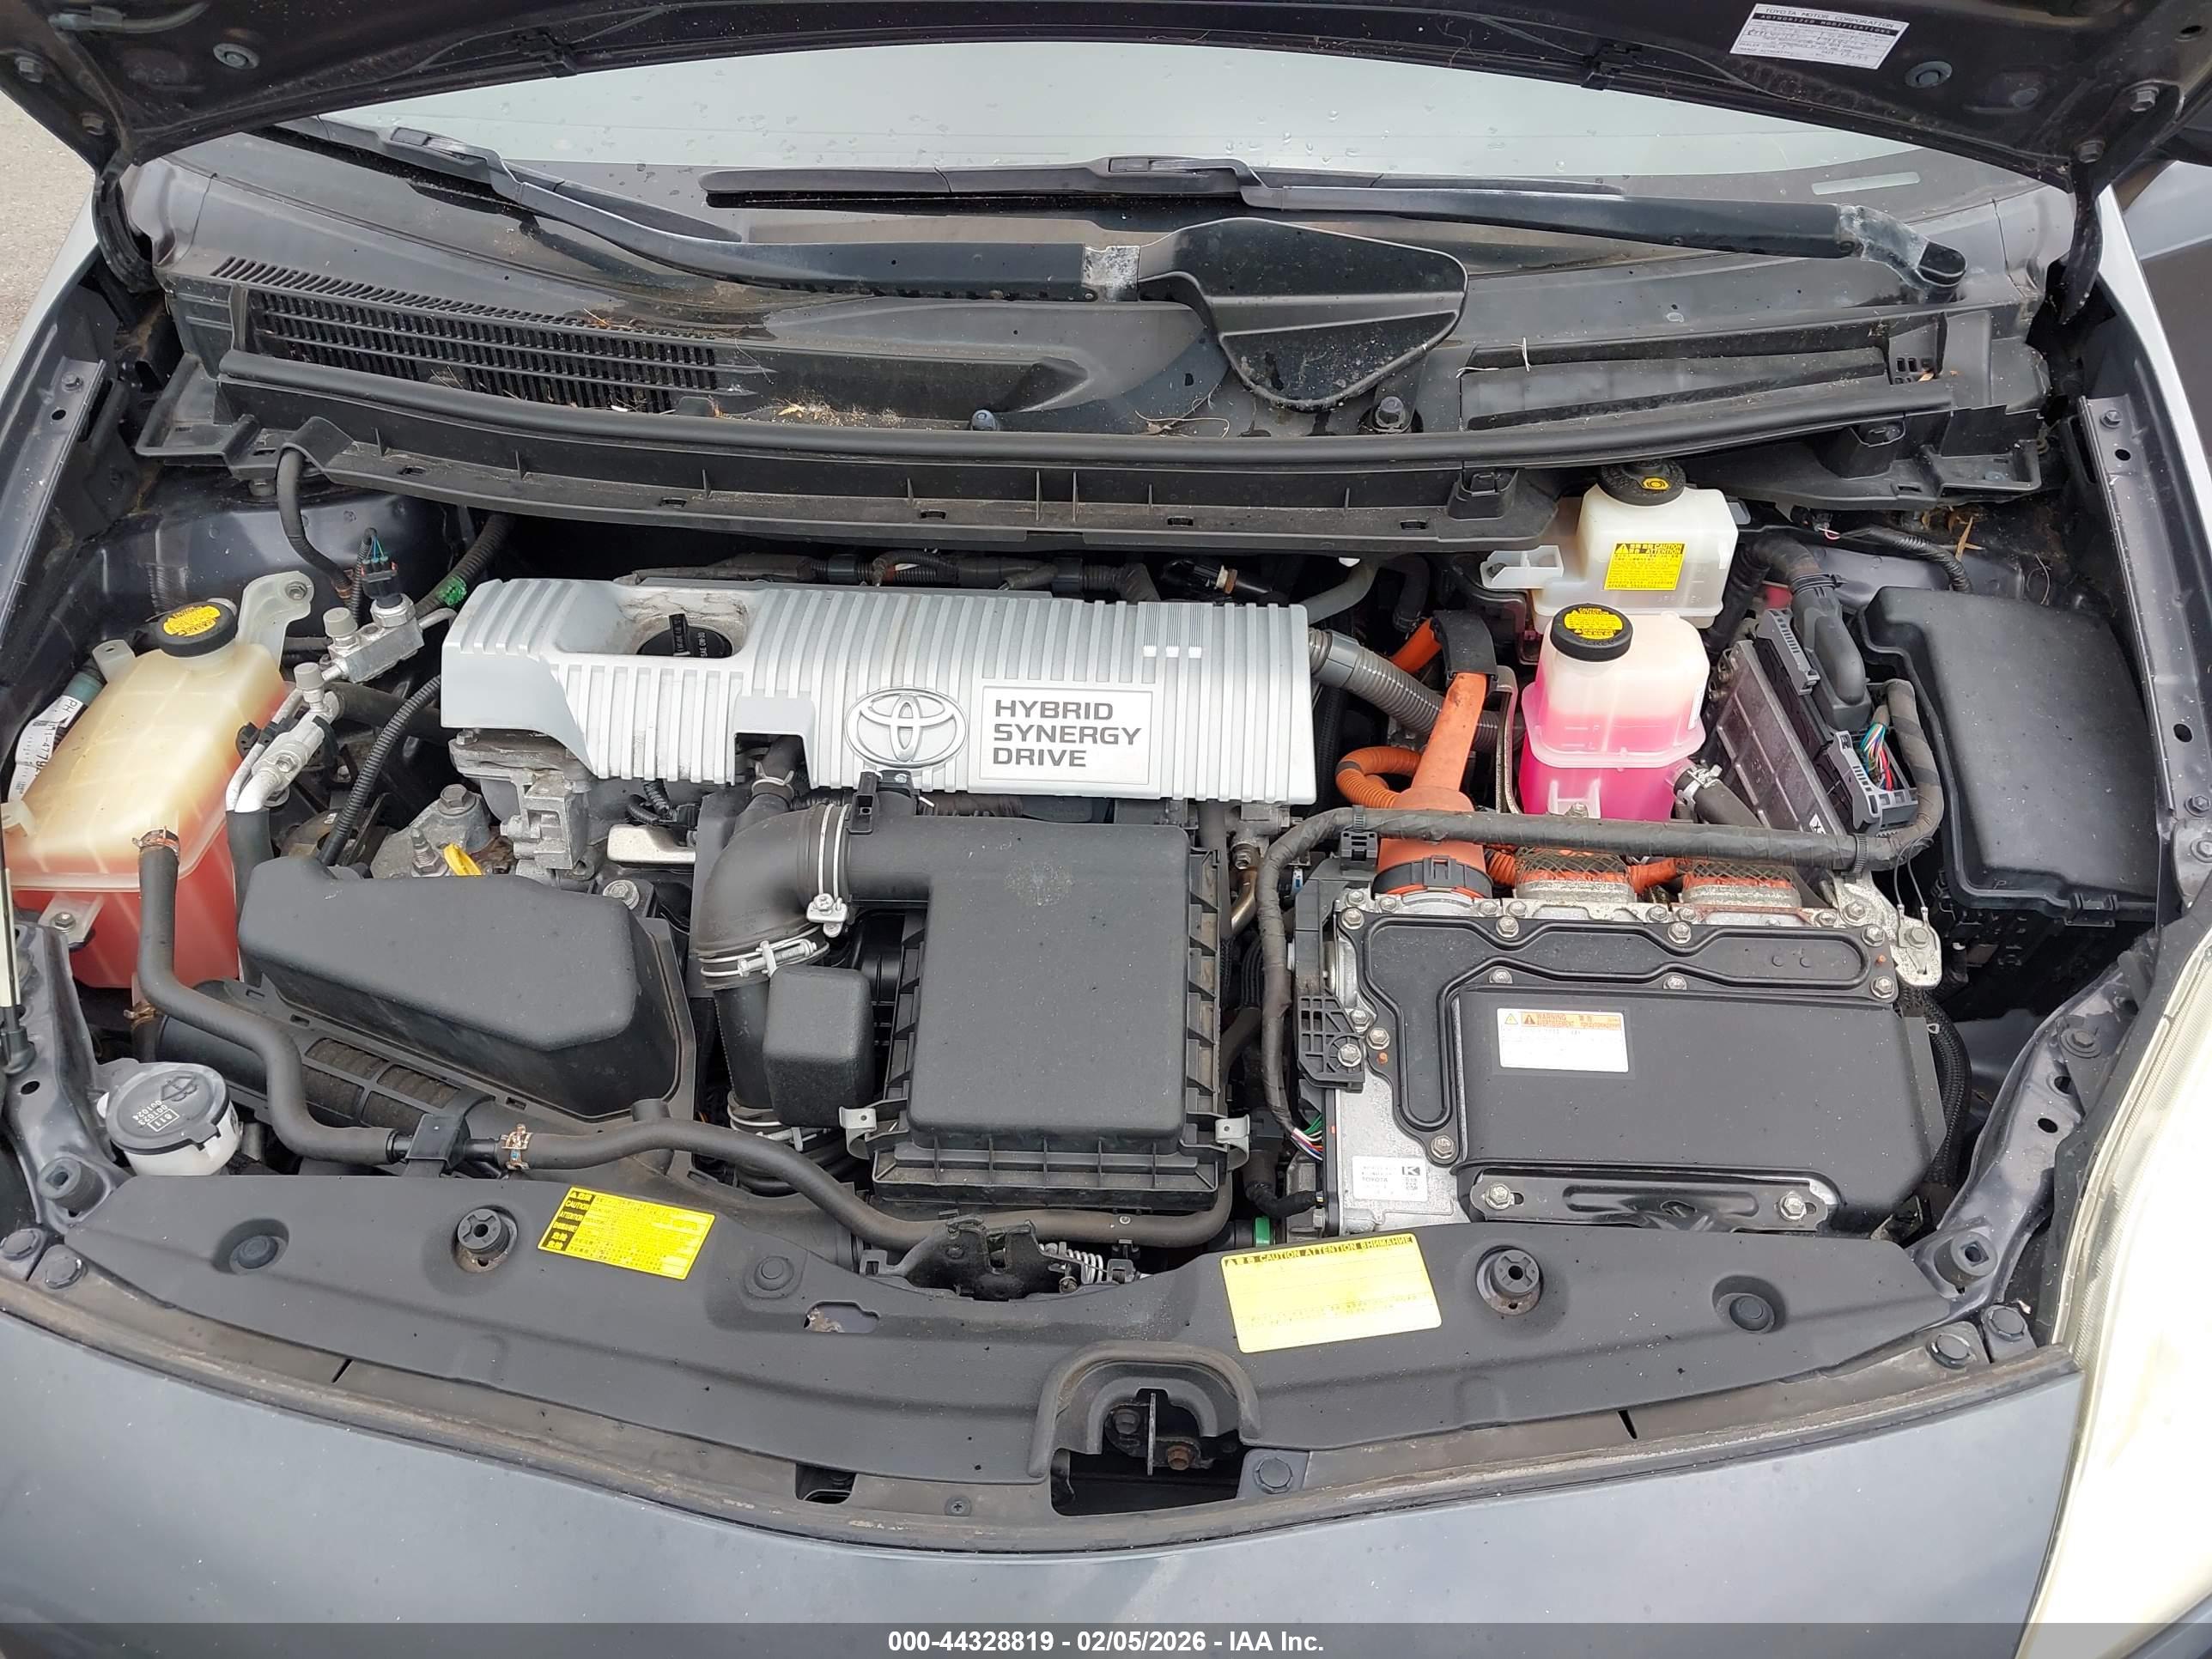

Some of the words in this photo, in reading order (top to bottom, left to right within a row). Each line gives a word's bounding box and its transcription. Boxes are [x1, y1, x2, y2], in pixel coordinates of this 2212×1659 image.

[1760, 15, 1815, 25] AUTHORIZED
[1820, 20, 1892, 34] MODIFICATIONS
[1802, 11, 1830, 20] MOTOR
[1834, 15, 1895, 28] CORPORATION
[63, 698, 77, 713] PH
[996, 699, 1114, 720] HYBRID
[993, 723, 1142, 746] SYNERGY
[992, 747, 1087, 767] DRIVE
[565, 1200, 592, 1211] CAUTION
[1259, 1250, 1301, 1263] CAUTION
[1305, 1243, 1358, 1257] ATTENTION
[1361, 1237, 1412, 1250] ВНИМАНИЕ
